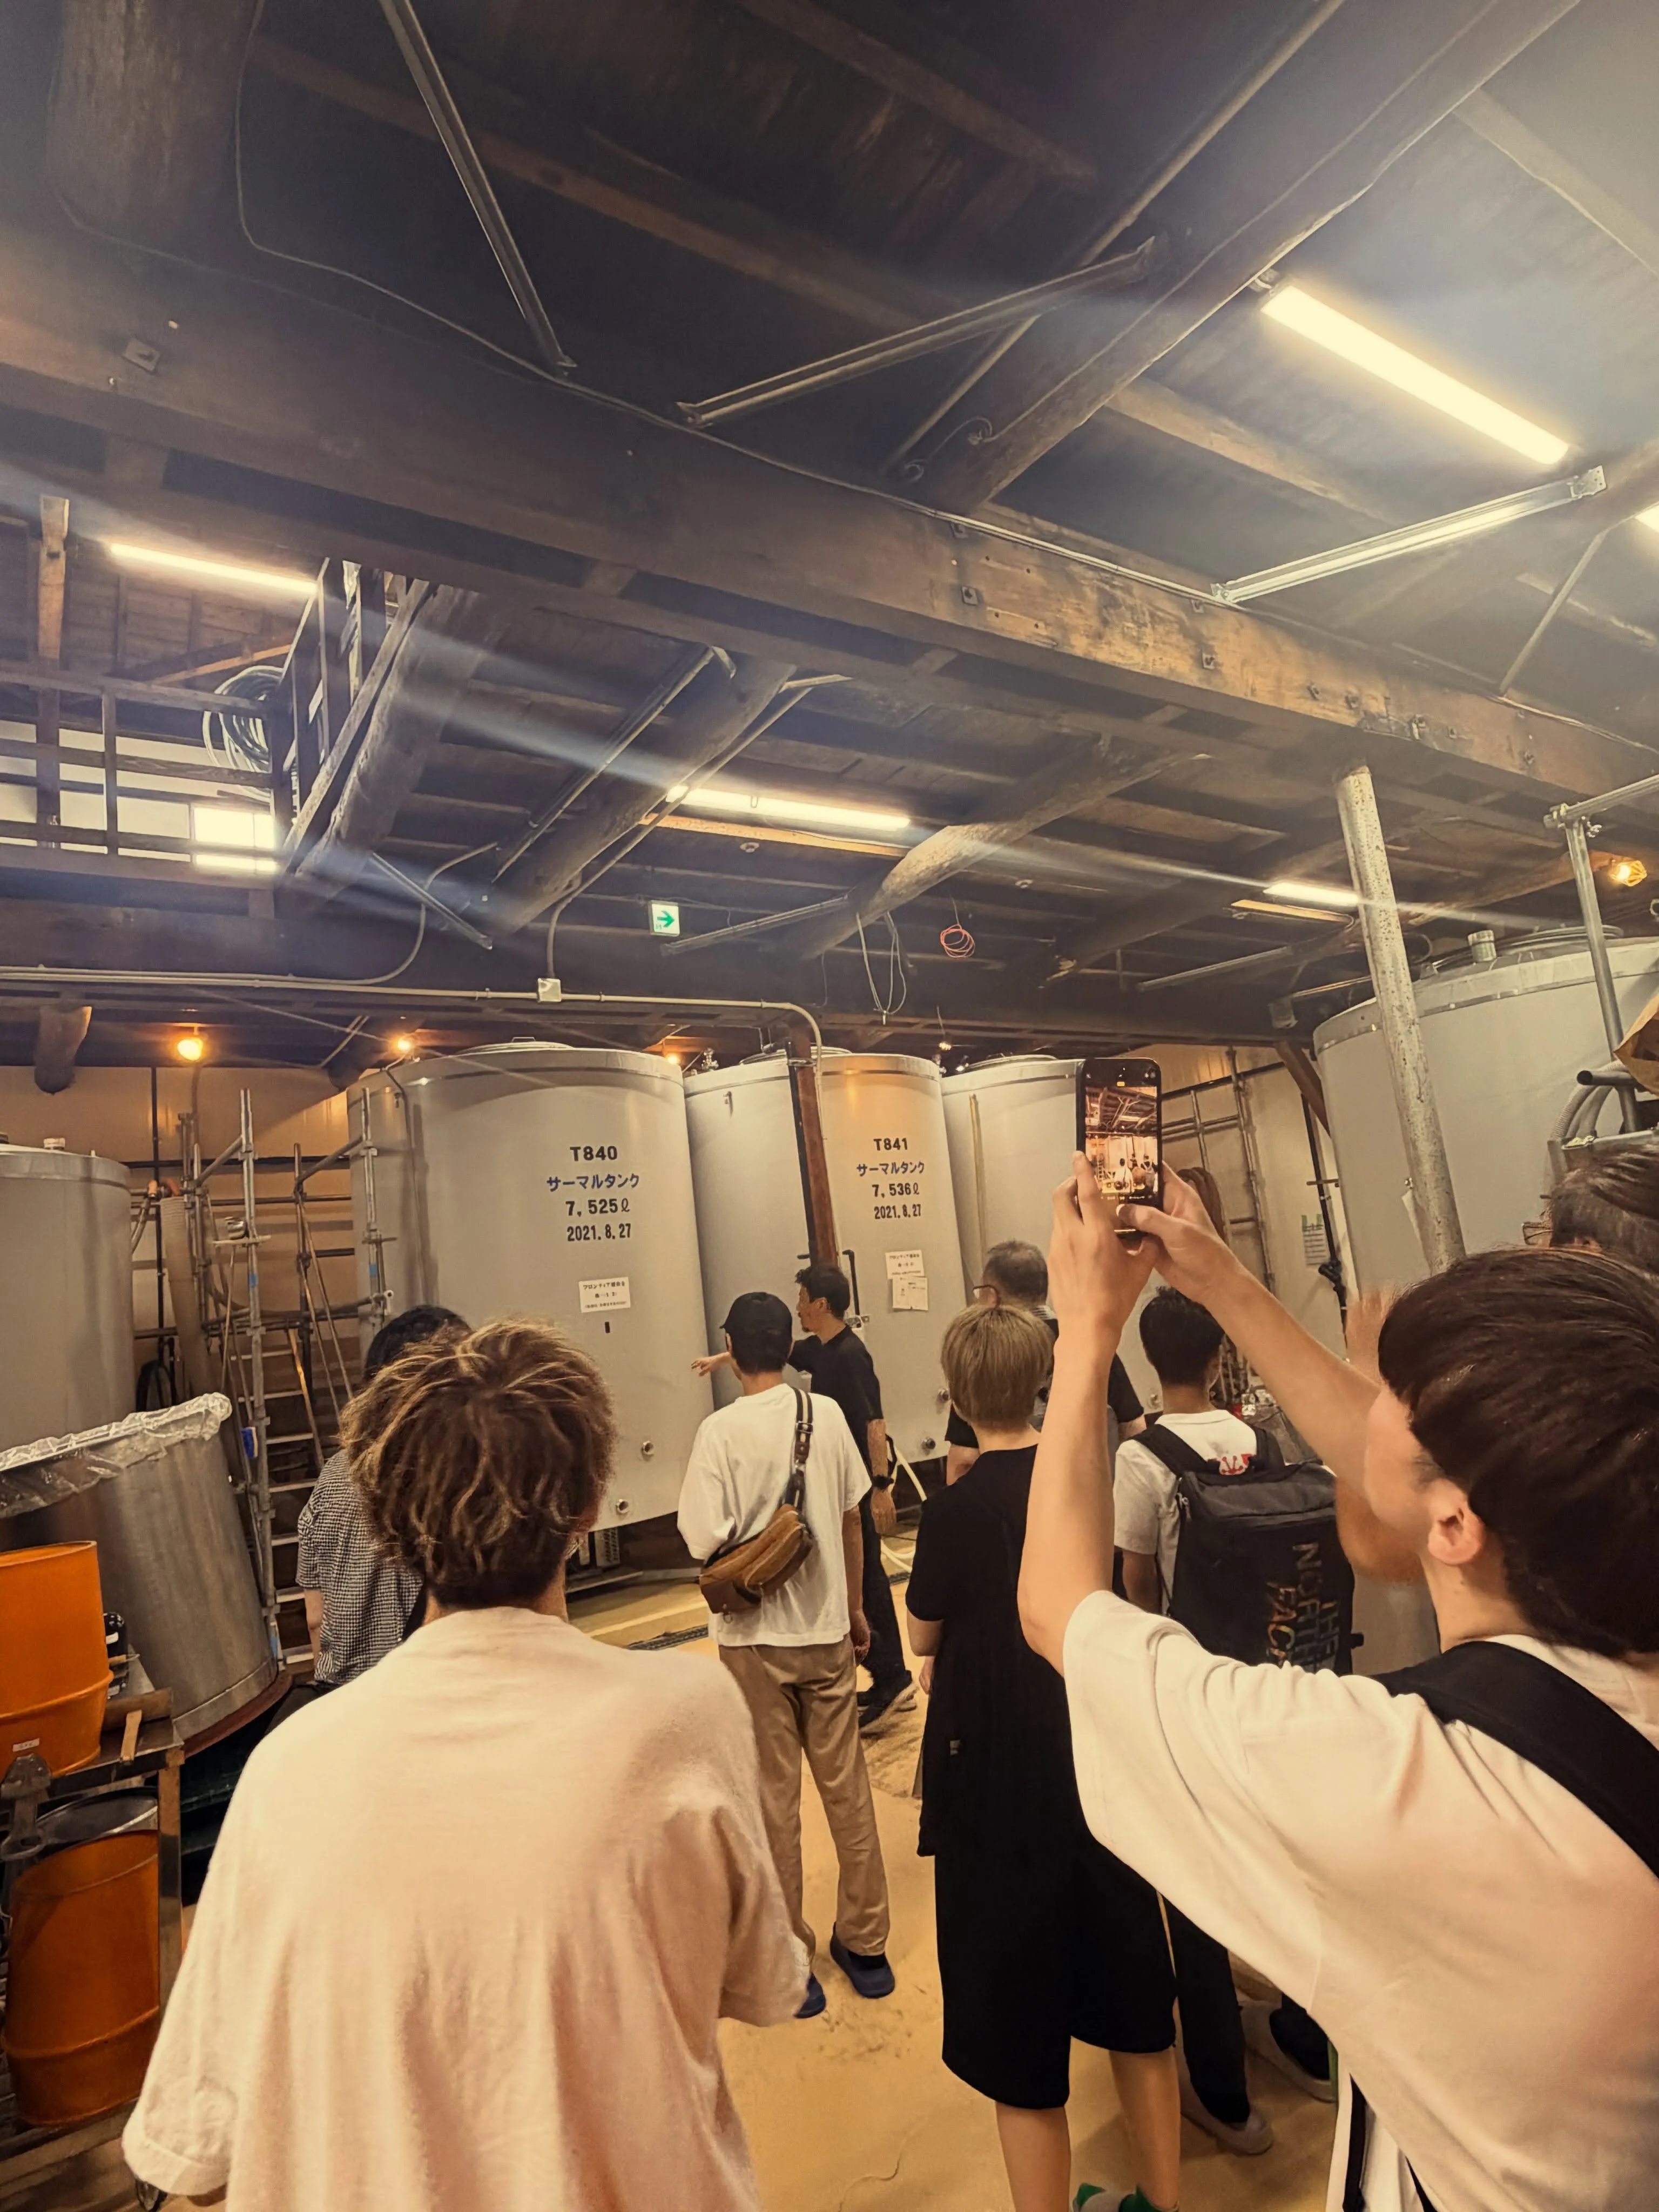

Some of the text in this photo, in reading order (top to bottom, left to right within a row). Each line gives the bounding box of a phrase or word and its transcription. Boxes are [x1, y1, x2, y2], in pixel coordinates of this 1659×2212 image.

[873, 1137, 908, 1151] T841
[569, 1145, 618, 1162] T840
[856, 1161, 925, 1177] サーマルタンク
[546, 1172, 640, 1192] サーマルタンク
[873, 1203, 921, 1220] 2021.8.27
[567, 1223, 631, 1242] 2021.8.27
